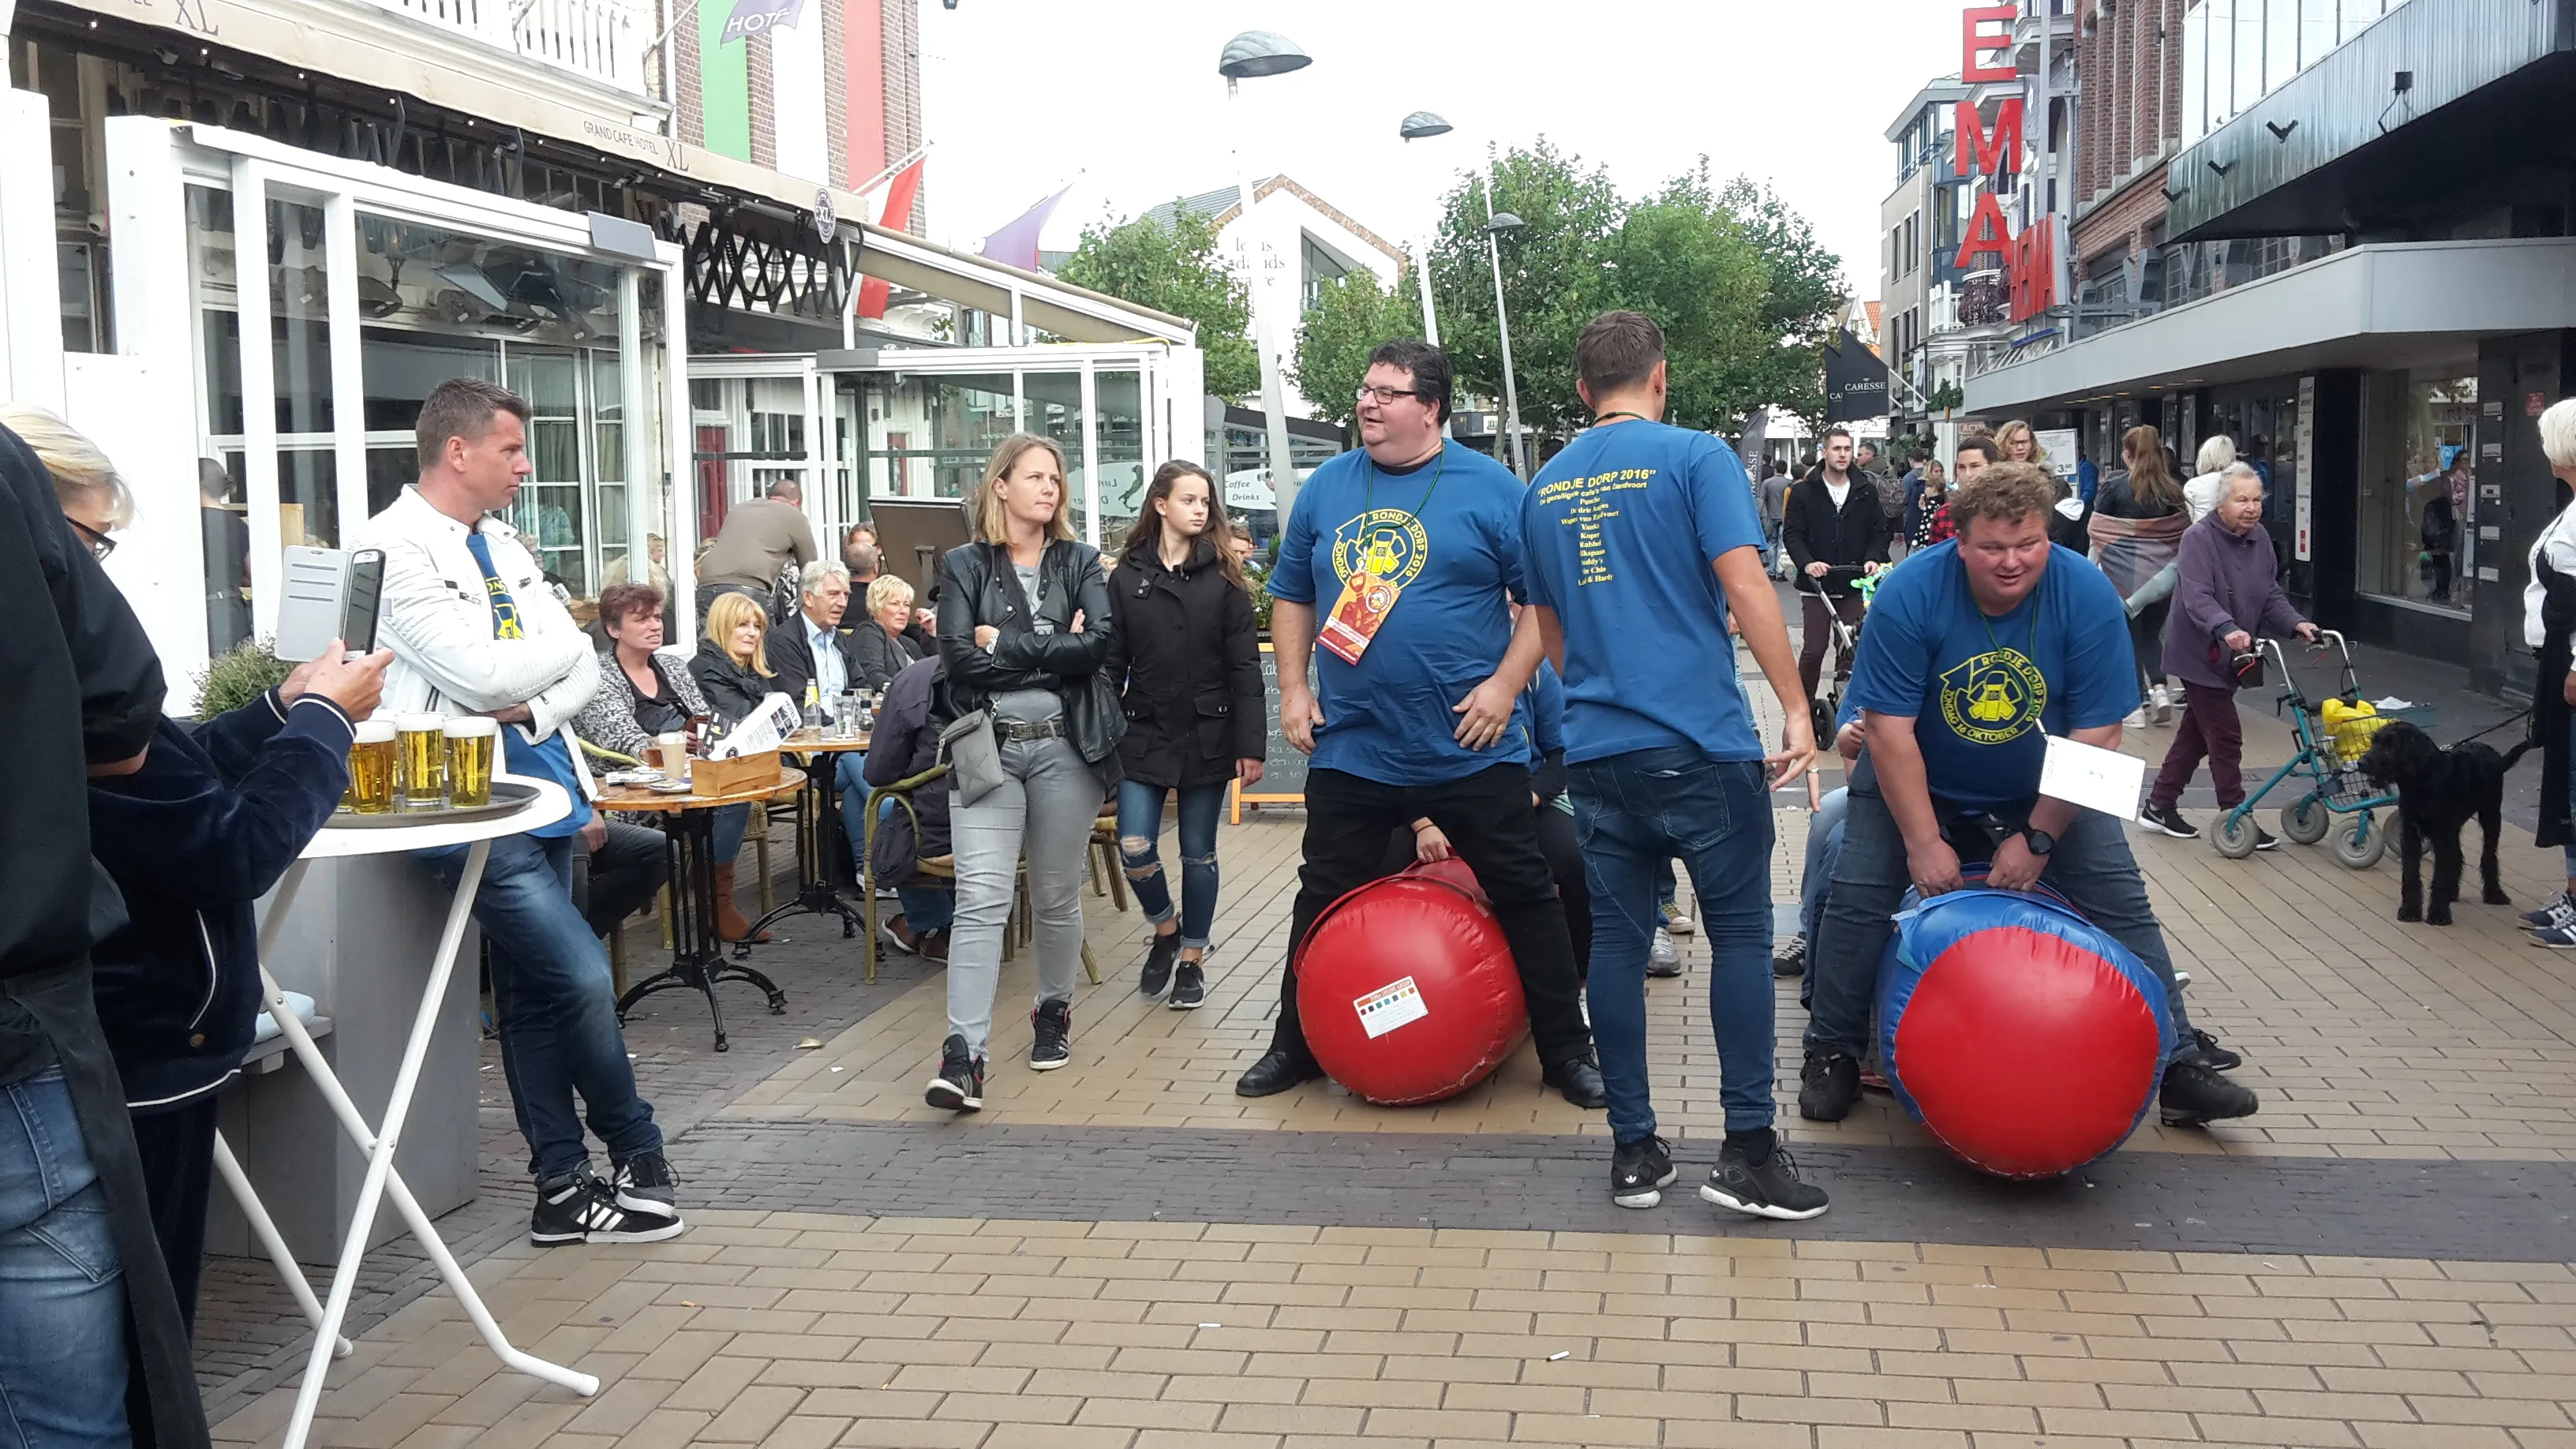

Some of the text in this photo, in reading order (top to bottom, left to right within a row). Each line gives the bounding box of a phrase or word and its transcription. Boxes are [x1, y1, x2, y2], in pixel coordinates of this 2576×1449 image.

[175, 0, 219, 36] XL
[583, 121, 612, 140] GRAND
[634, 136, 659, 155] HOTEL
[665, 140, 690, 172] XL
[818, 205, 833, 223] XL
[1844, 381, 1886, 391] CARESSE
[1225, 481, 1251, 489] Coffee
[1588, 471, 1618, 488] DORP
[1335, 541, 1349, 578] ZONDAG
[1405, 554, 1424, 578] 2016
[1981, 651, 2025, 669] RODJE
[1944, 688, 2019, 742] ZONDAG 16 OKTOBER
